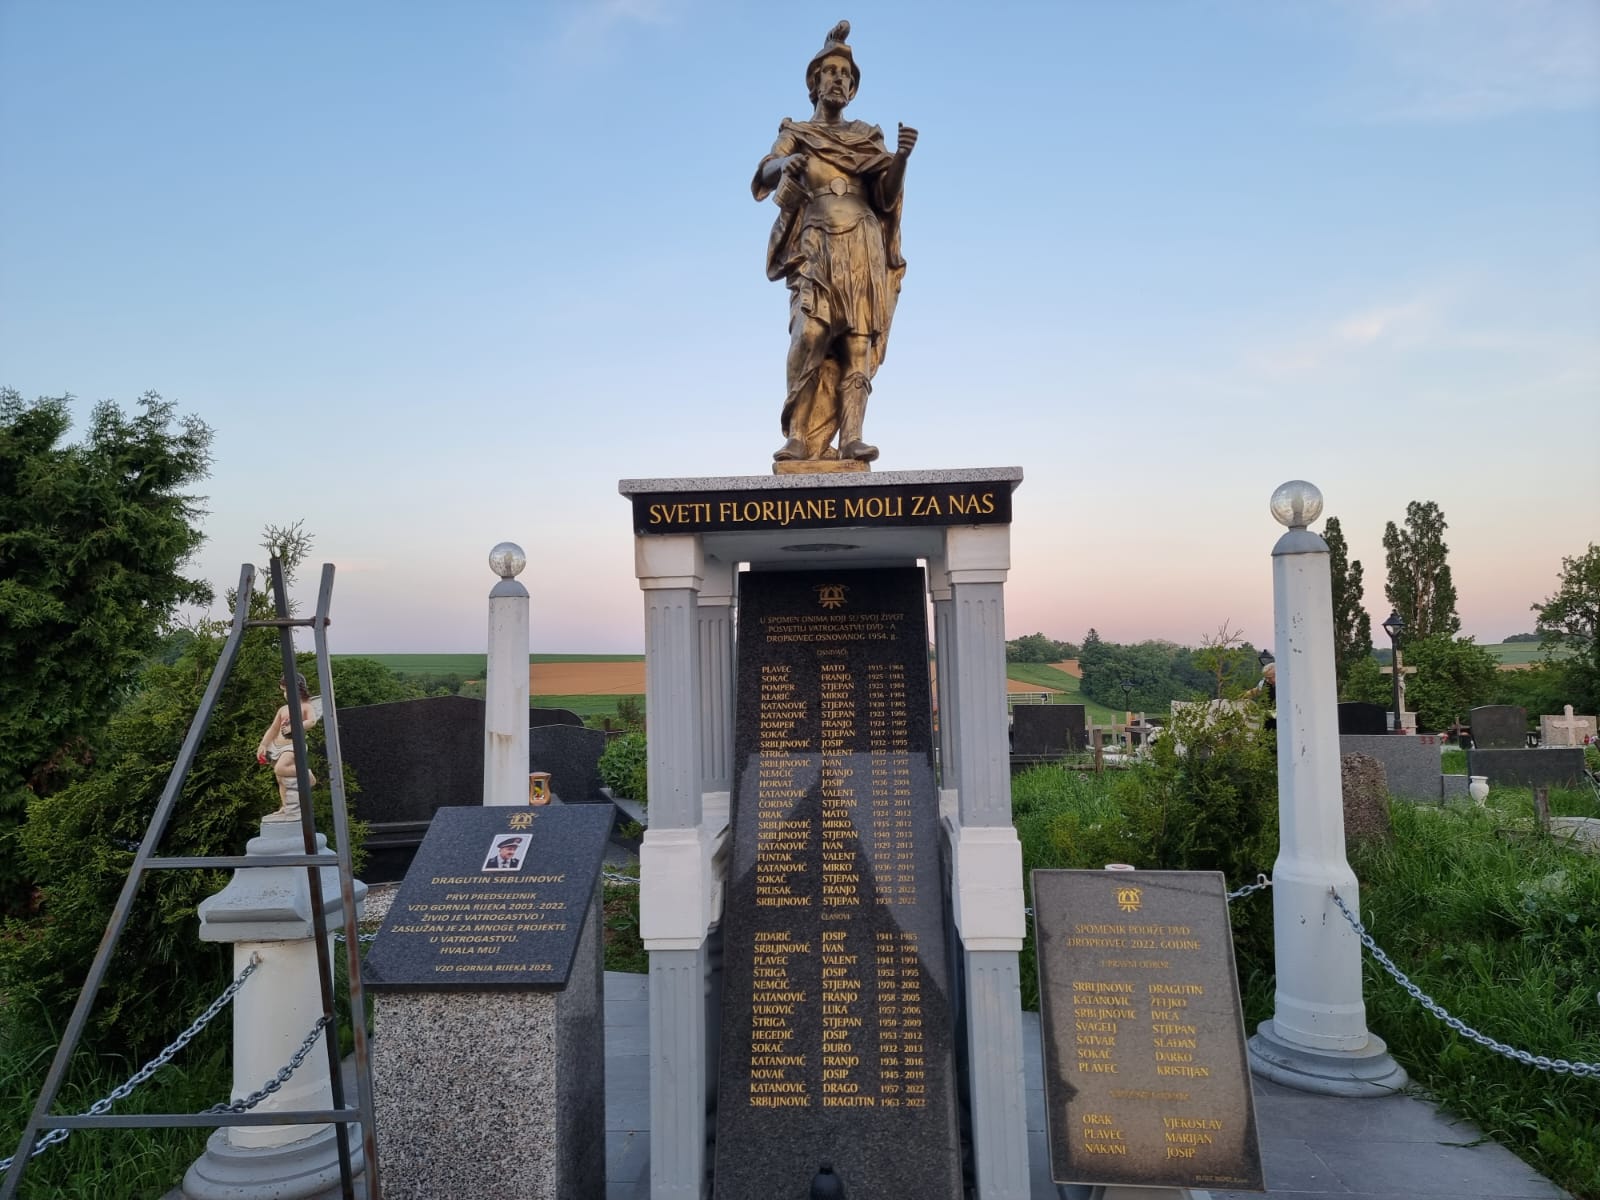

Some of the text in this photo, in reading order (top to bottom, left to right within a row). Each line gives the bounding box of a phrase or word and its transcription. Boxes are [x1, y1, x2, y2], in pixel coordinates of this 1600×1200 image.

[649, 493, 995, 526] SVETI FLORIJANE MOLI ZA NAS
[821, 664, 845, 672] MATO
[762, 672, 851, 683] SOKAČ FRANJO
[821, 682, 854, 692] STJEPAN
[761, 700, 855, 710] KATANOVIĆ STJEPAN
[761, 709, 855, 720] KATANOVIĆ STJEPAN
[760, 720, 852, 729] POMPER FRANJO
[760, 728, 856, 739] SOKAČ STJEPAN
[761, 738, 843, 750] SRBLJINOVIĆ JOSIP
[822, 749, 853, 757] VALENT
[760, 757, 842, 769] SRBLJINOVIĆ IVAN
[822, 768, 853, 778] FRANJO
[759, 779, 843, 788] HORVAT JOSIP
[759, 787, 853, 798] KATANOVIĆ VALENT
[822, 799, 857, 809] STJEPAN
[758, 809, 848, 819] ORAK MATO
[759, 819, 851, 831] SRBLJINOVIĆ MIRKO
[758, 829, 858, 841] SRBLJINOVIĆ STJEPAN
[757, 840, 843, 850] KATANOVIĆ IVAN
[757, 852, 855, 861] FUNTAK VALENT
[757, 862, 852, 872] KATANOVIĆ MIRKO
[431, 874, 566, 885] DRAGUTIN SRBLJINOVIĆ
[757, 873, 859, 884] SOKAČ STJEPAN
[756, 885, 856, 895] PRUSAK FRANJO
[445, 892, 538, 901] PRVI PREDSJEDNIK
[757, 895, 860, 908] SRBLJINOVIĆ STJEPAN
[473, 903, 507, 911] RIJEKA
[421, 913, 450, 922] ŽIVIO
[464, 913, 540, 921] VATROGASTVO
[391, 924, 445, 933] ZASLUŽAN
[446, 924, 458, 932] JE
[458, 924, 472, 932] ZA
[516, 923, 567, 931] PROJEKTE
[1075, 924, 1126, 934] SPOMENIK
[1167, 926, 1191, 936] DVD
[441, 935, 519, 943] VATROGASTVU.
[822, 932, 846, 942] JOSIP
[754, 942, 844, 954] SRBLJINOVIĆ IVAN
[1067, 937, 1127, 947] DROPKOVEC
[1160, 940, 1201, 950] GODINE
[477, 946, 501, 954] MU!
[754, 955, 856, 965] PLAVEC VALENT
[455, 964, 493, 972] GORNJA
[822, 967, 846, 978] JOSIP
[823, 980, 861, 990] STJEPAN
[1148, 984, 1203, 995] DRAGUTIN
[753, 990, 858, 1003] KATANOVIĆ FRANJO
[753, 1003, 847, 1014] VUKOVIĆ LUKA
[1151, 1010, 1180, 1021] IVICA
[823, 1017, 862, 1028] STJEPAN
[1152, 1024, 1197, 1035] STJEPAN
[823, 1030, 848, 1041] JOSIP
[752, 1041, 783, 1052] SOKAČ
[751, 1054, 859, 1067] KATANOVIĆ FRANJO
[1155, 1051, 1193, 1062] DARKO
[751, 1069, 848, 1081] NOVAK JOSIP
[1078, 1062, 1209, 1078] PLAVEC KRISTIJAN
[750, 1081, 858, 1092] KATANOVIĆ DRAGO
[750, 1094, 875, 1108] SRBLJINOVIĆ DRAGUTIN
[1082, 1114, 1222, 1129] ORAK VJEKOSLAV
[1084, 1128, 1212, 1145] PLAVEC MARIJAN
[1167, 1147, 1196, 1159] JOSIP
